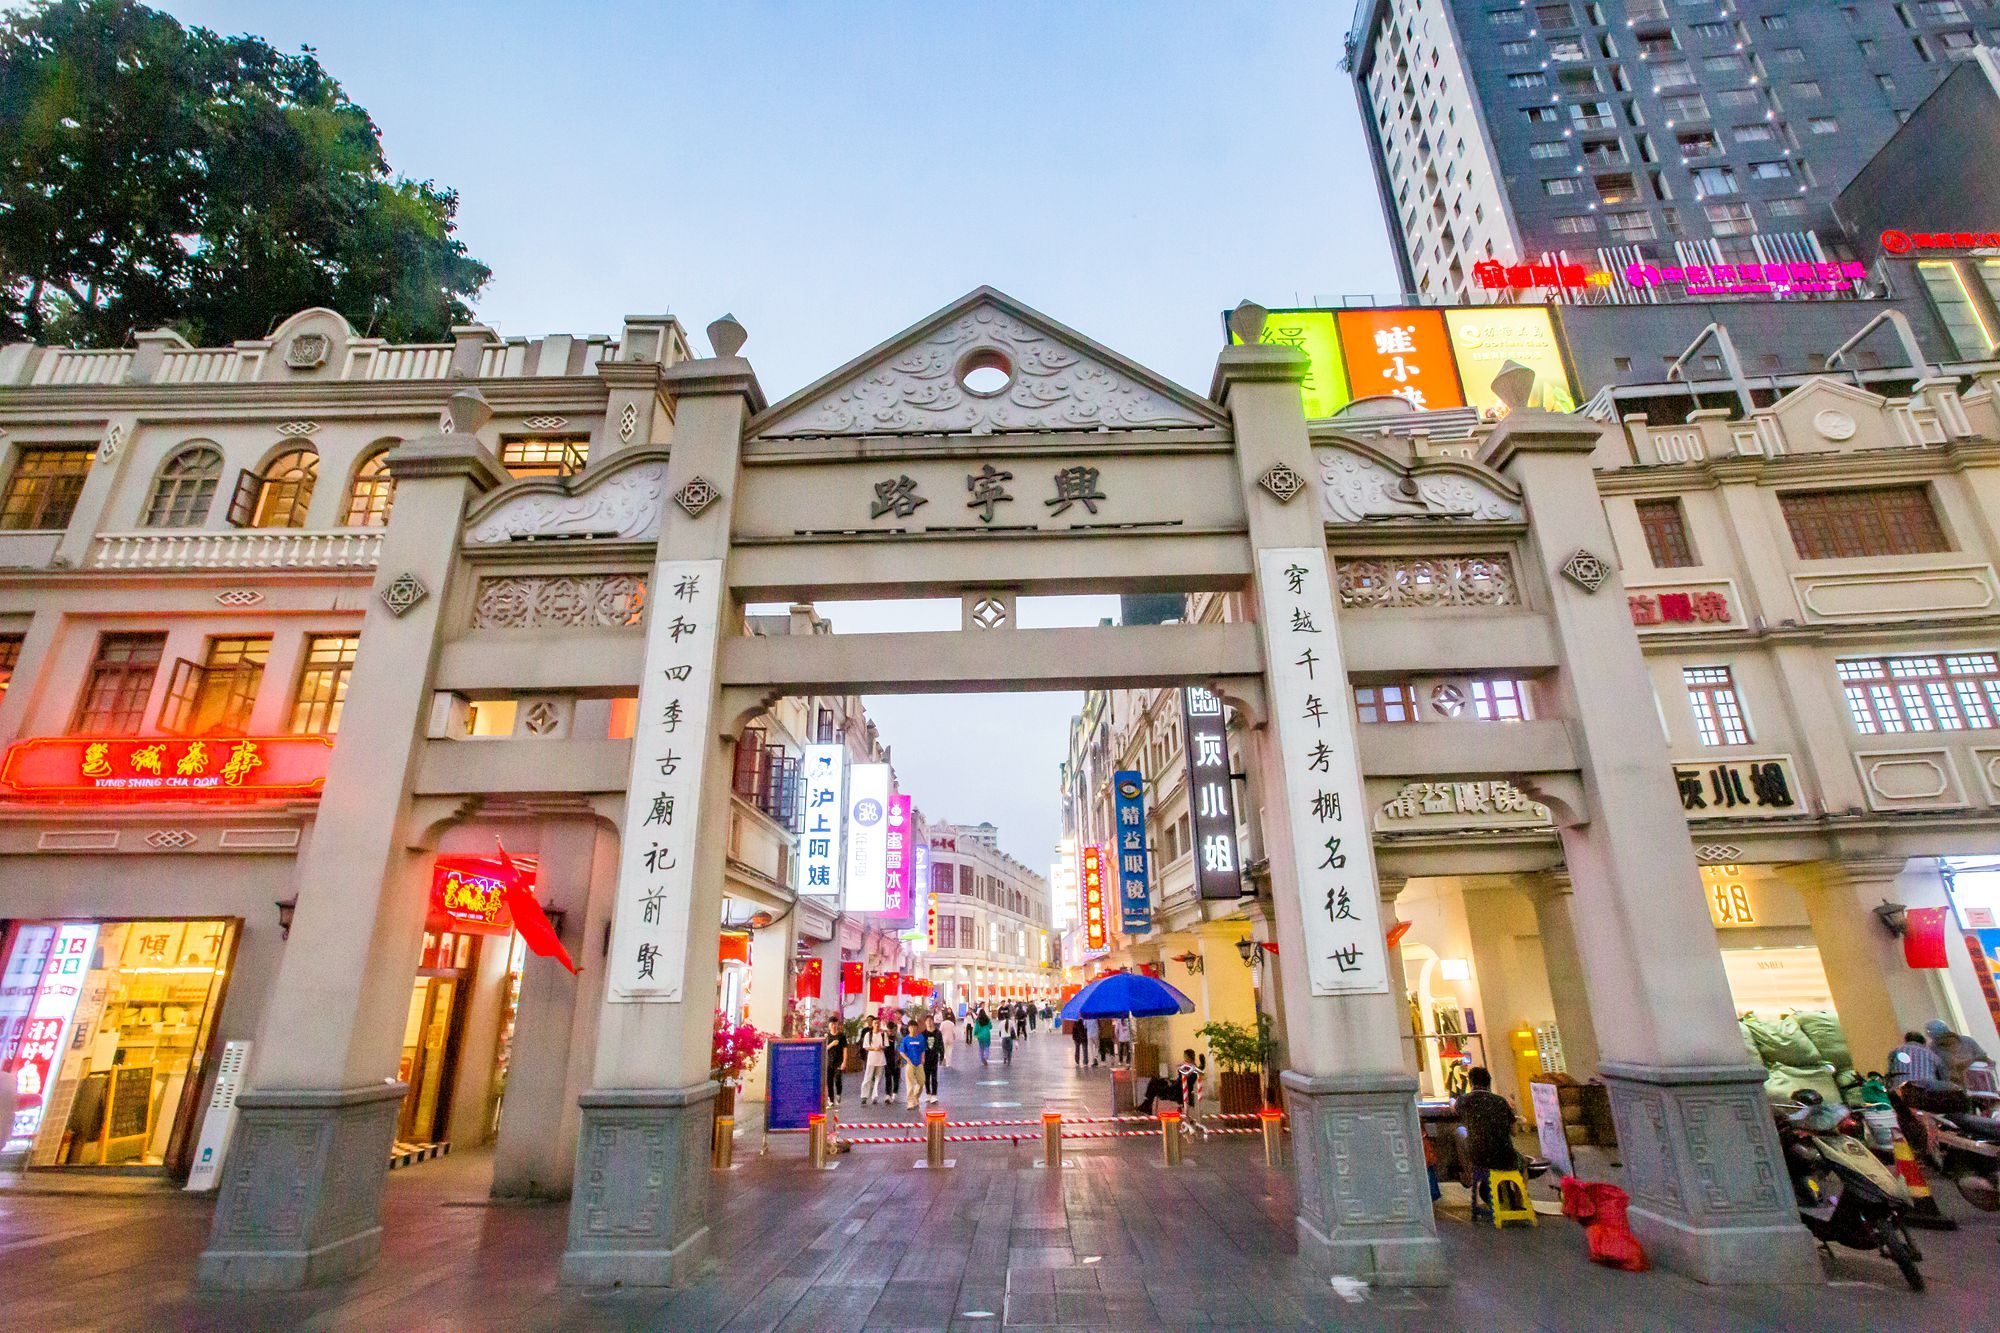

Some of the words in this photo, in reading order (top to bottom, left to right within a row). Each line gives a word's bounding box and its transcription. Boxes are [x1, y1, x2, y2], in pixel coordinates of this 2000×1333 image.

[166, 777, 188, 787] CHA
[1194, 732, 1235, 872] 灰小姐
[808, 788, 835, 887] 沪上阿姨
[1121, 806, 1146, 900] 精益眼镜
